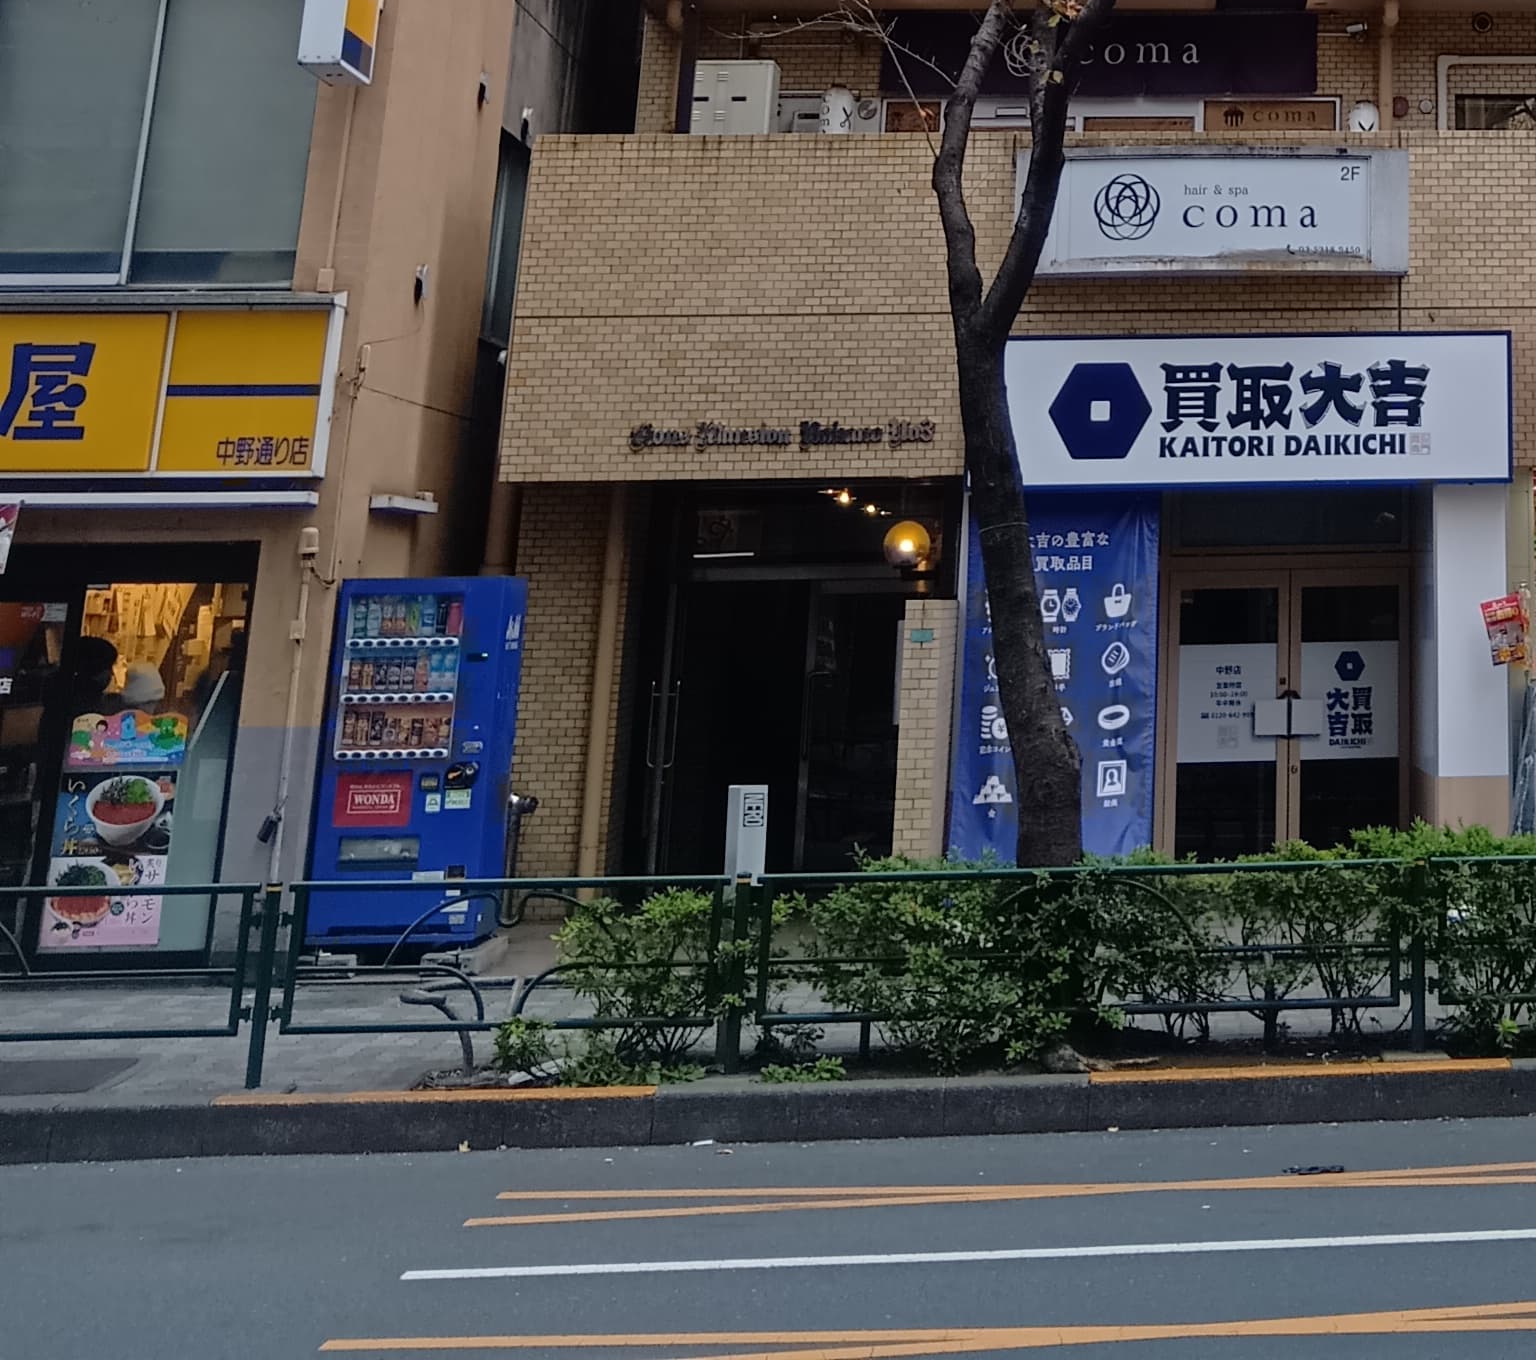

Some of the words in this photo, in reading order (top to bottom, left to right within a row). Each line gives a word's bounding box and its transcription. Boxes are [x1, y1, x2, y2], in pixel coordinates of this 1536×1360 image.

[1253, 109, 1317, 122] coma
[1340, 166, 1361, 181] 2F
[1184, 184, 1207, 196] hair
[1213, 185, 1223, 196] &
[1228, 187, 1249, 198] spa
[1182, 204, 1318, 228] coma
[0, 341, 96, 440] 屋
[1159, 359, 1431, 433] 買取大吉
[216, 436, 310, 466] 中野通り店
[1159, 435, 1275, 458] KAITORI
[1285, 433, 1407, 456] DAIKICHI
[1033, 555, 1093, 572] 買取品目
[1215, 665, 1242, 676] 中野店
[352, 793, 396, 806] WONDA
[61, 777, 86, 856] いくら丼
[142, 858, 162, 925] 炙りサモン
